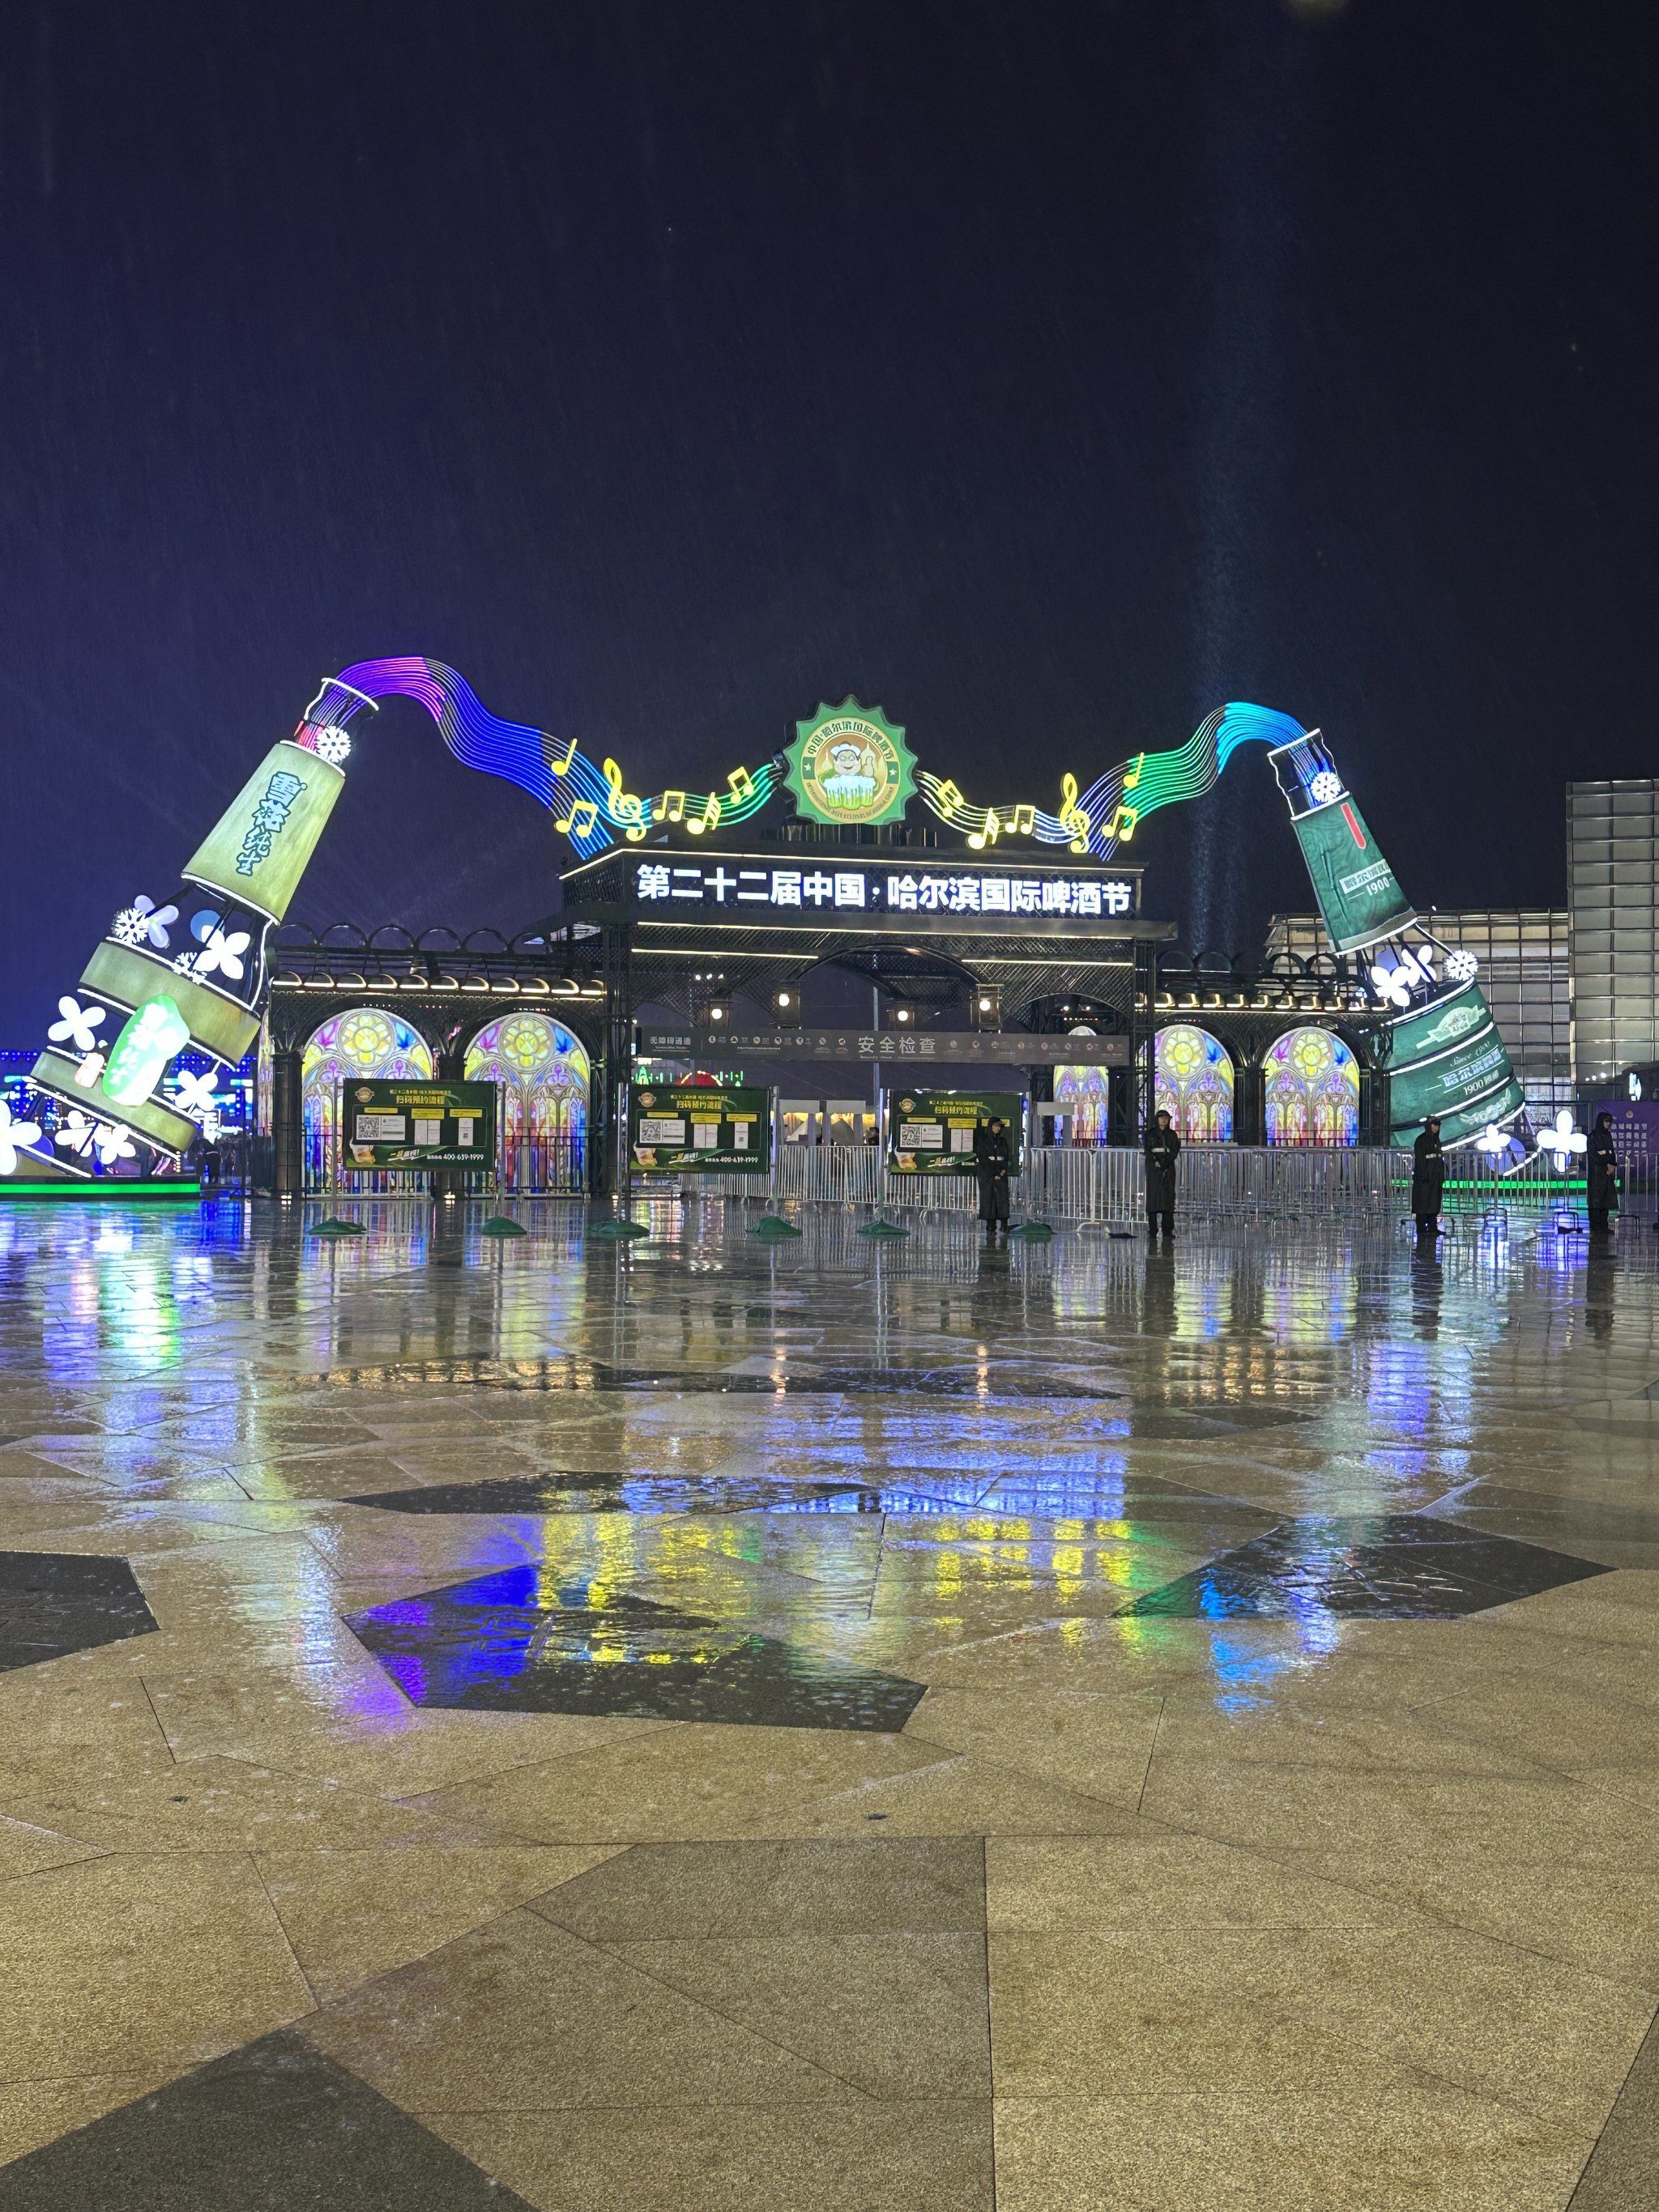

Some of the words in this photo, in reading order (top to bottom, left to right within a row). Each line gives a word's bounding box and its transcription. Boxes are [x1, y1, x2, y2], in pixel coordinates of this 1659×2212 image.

[236, 770, 308, 877] 雪花纯生
[637, 864, 1132, 915] 第二十二届中国·哈尔滨国际啤酒节
[1366, 876, 1390, 896] 1900
[858, 1036, 936, 1054] 安全检查
